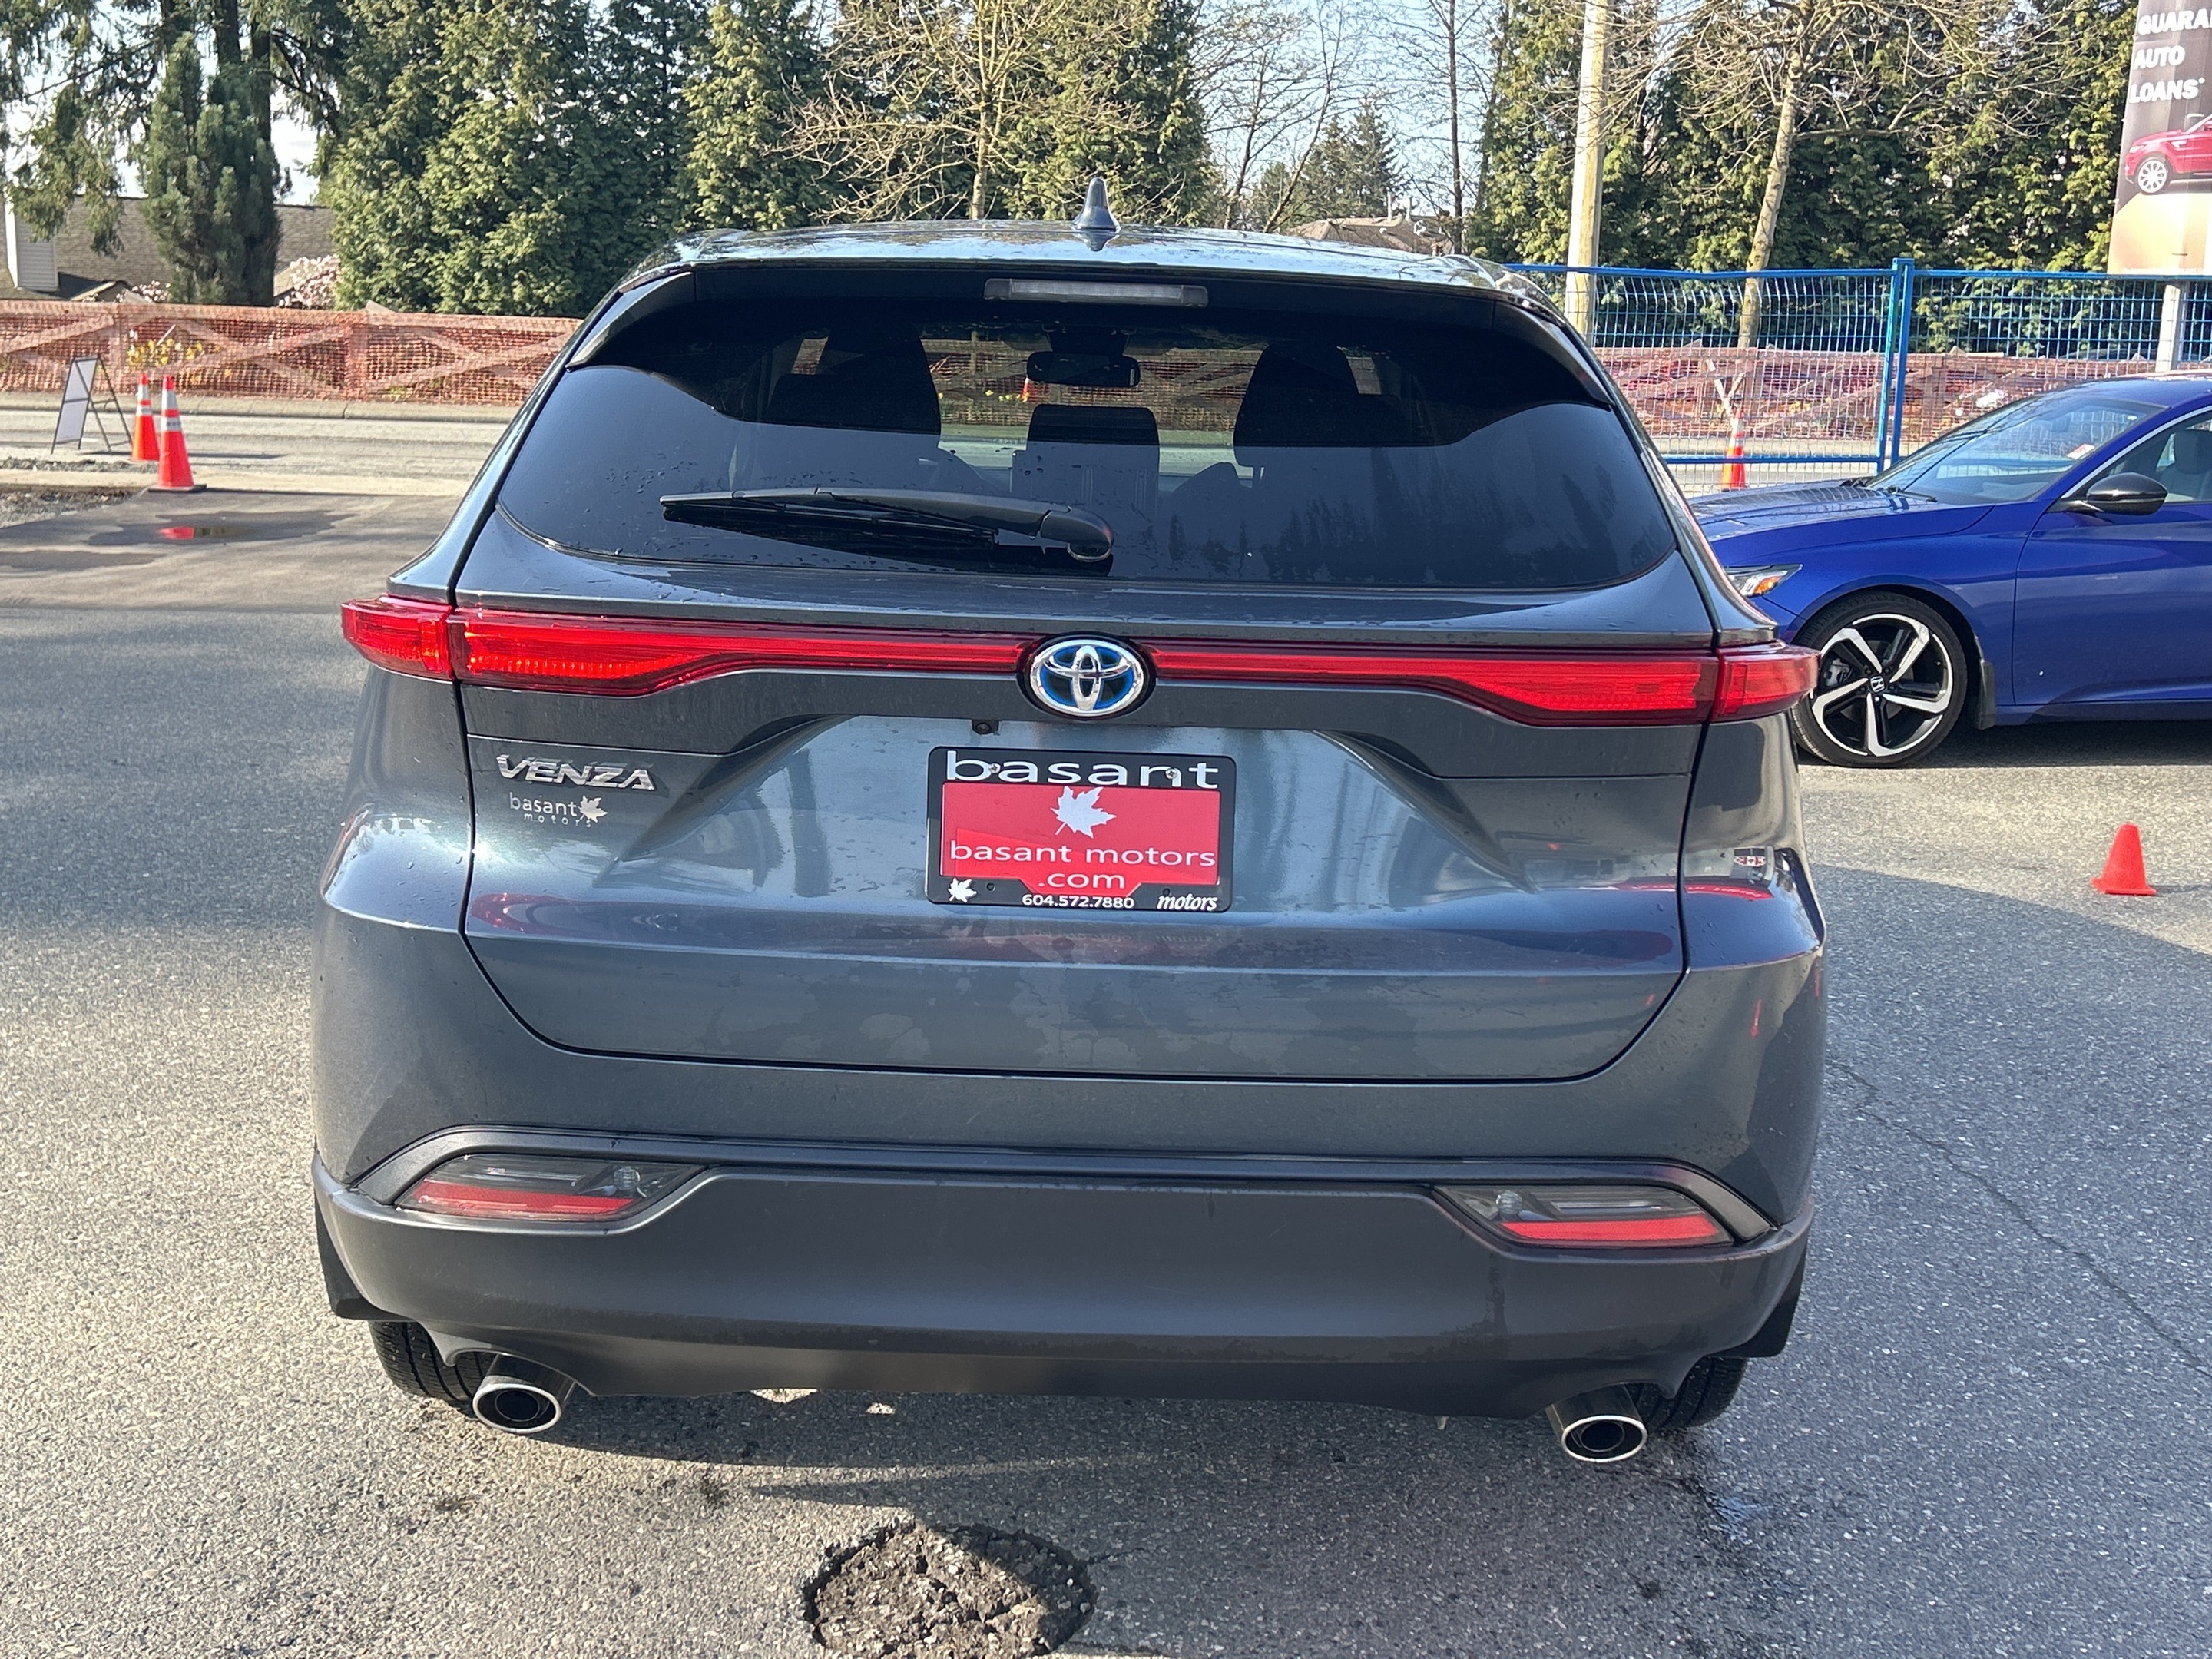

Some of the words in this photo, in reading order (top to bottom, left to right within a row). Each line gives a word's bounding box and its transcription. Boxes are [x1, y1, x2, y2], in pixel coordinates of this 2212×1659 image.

[2138, 8, 2212, 35] GUARA
[2133, 45, 2186, 70] AUTO
[496, 755, 654, 790] VENZA
[945, 750, 1219, 790] basant
[509, 792, 578, 817] basant
[523, 813, 591, 828] motors
[950, 840, 1073, 863] basant
[1085, 843, 1217, 866] motors
[1038, 873, 1126, 889] .com
[1022, 893, 1134, 909] 604.572.7880
[1156, 893, 1219, 912] motors
